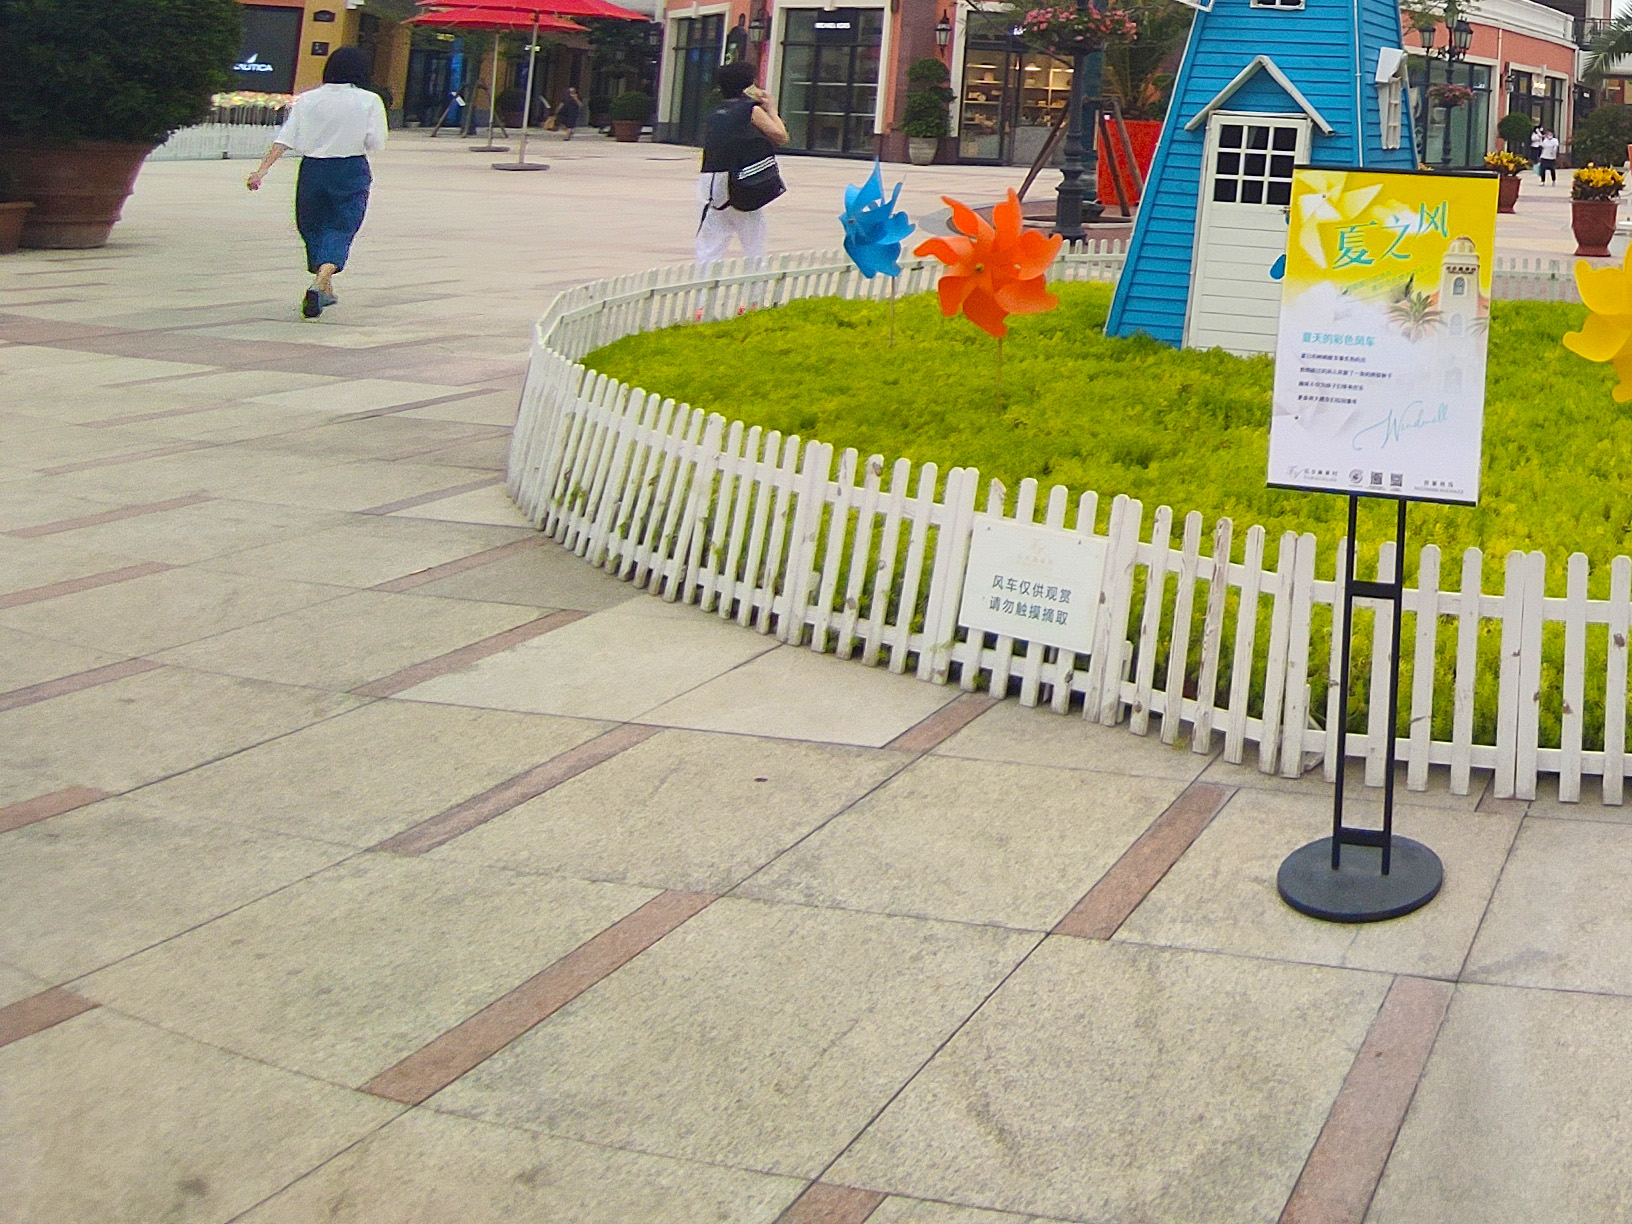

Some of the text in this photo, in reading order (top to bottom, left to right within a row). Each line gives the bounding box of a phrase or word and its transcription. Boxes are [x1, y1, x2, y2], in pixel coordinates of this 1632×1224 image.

[1332, 200, 1448, 269] 夏之风
[992, 575, 1071, 604] 风车仅供观赏
[989, 596, 1069, 626] 请勿触摸摘取
